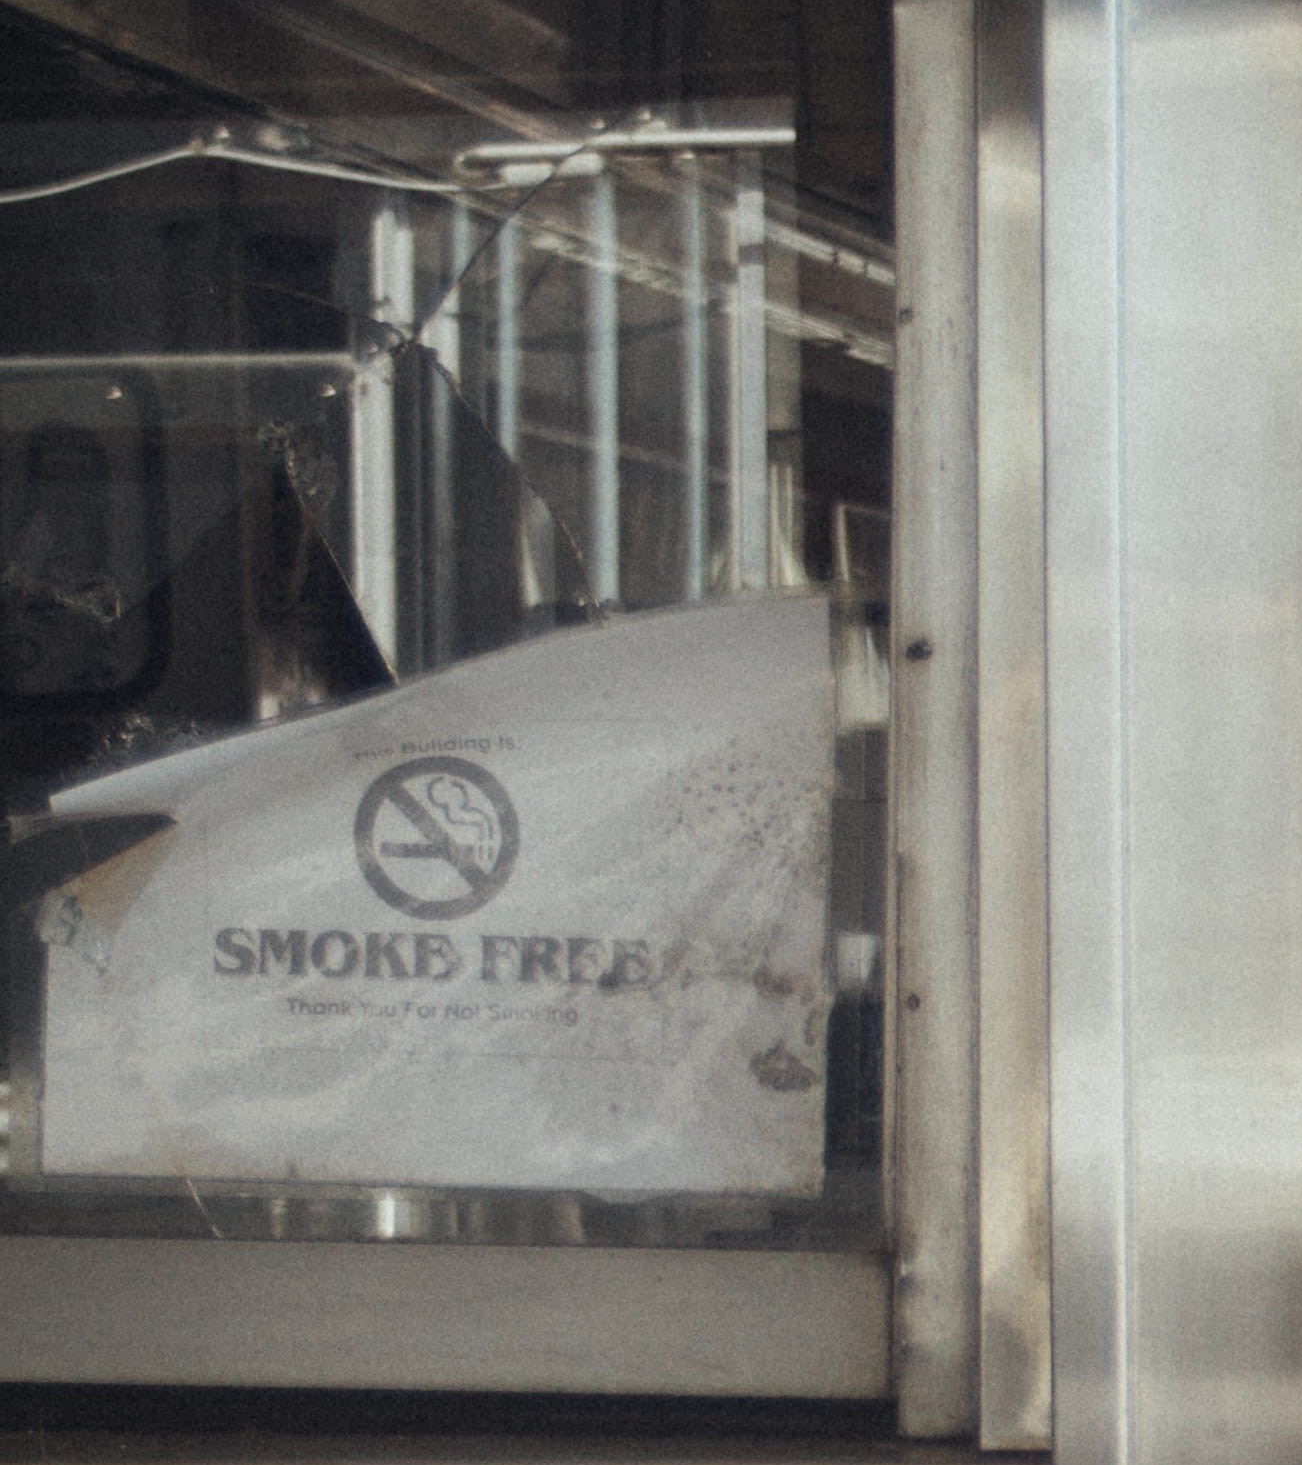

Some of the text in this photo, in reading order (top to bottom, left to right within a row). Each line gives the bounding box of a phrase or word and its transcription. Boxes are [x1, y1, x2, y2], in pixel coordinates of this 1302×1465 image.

[399, 737, 491, 754] Building
[214, 927, 650, 985] SMOKE FREE
[286, 997, 578, 1026] Thank You For Not Smoking
